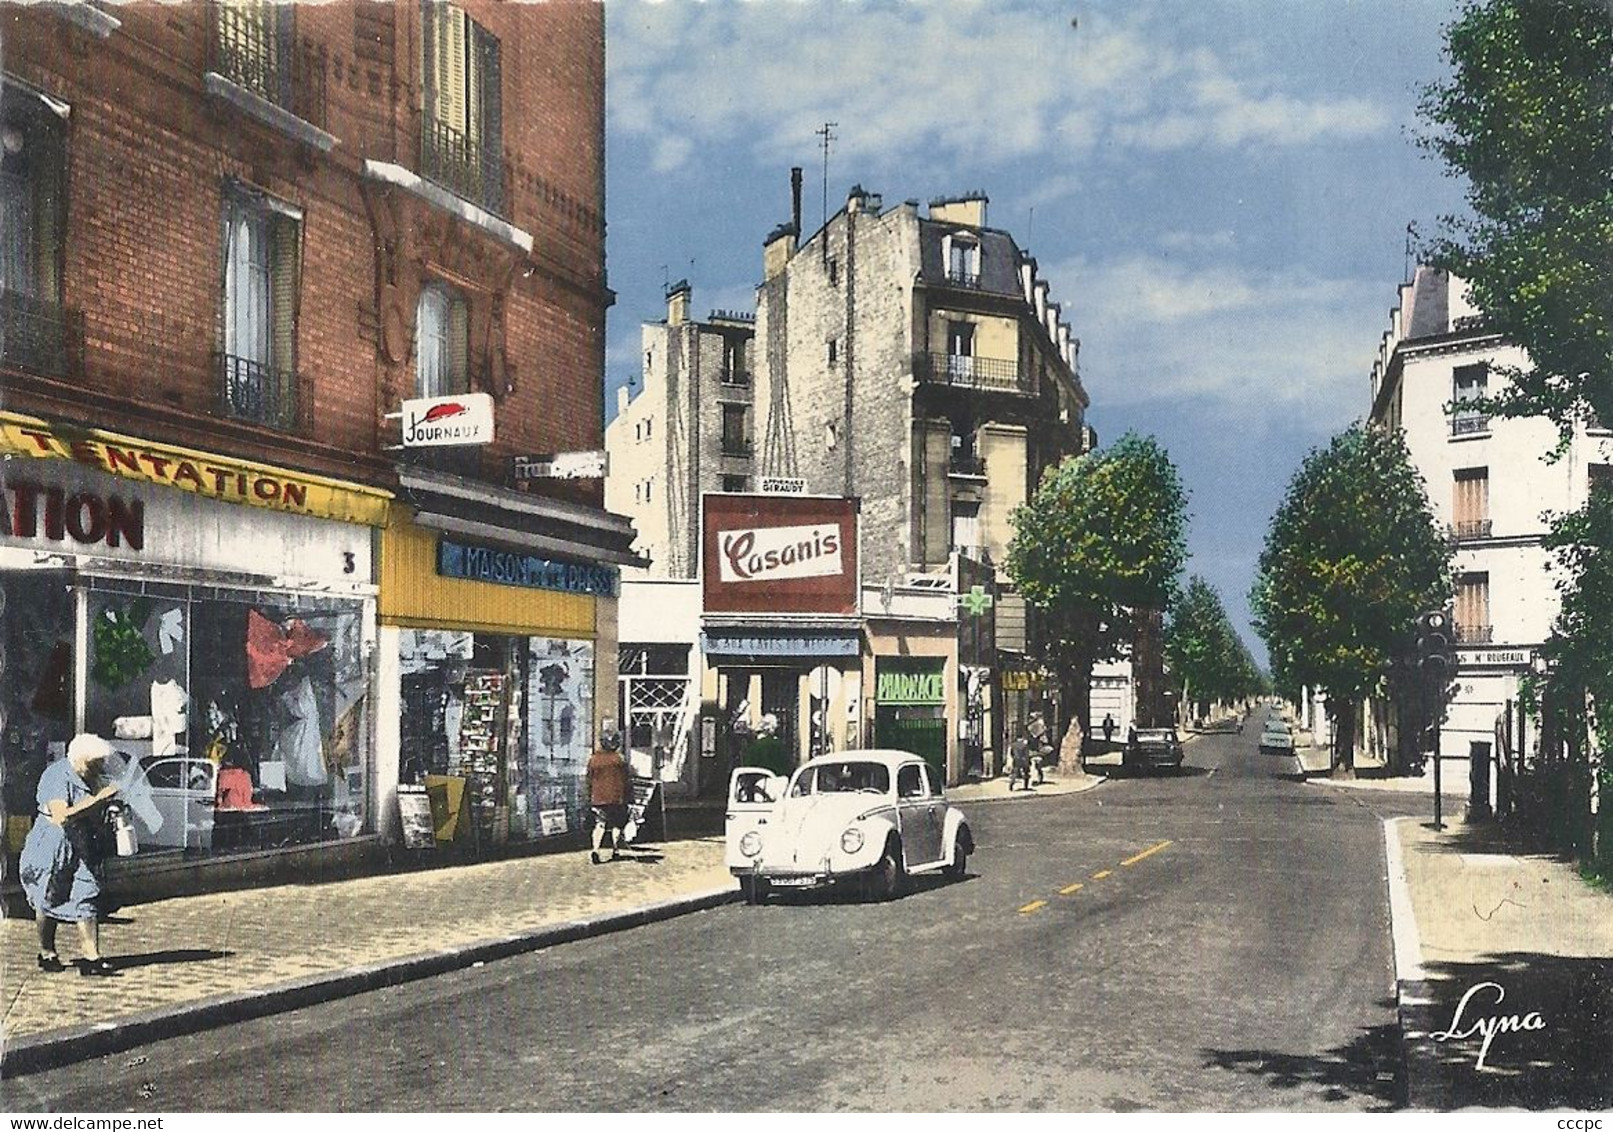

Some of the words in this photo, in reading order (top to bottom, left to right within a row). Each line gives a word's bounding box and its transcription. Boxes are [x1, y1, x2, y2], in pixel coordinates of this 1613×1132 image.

[405, 412, 479, 442] JOURNAUX
[343, 551, 356, 574] 3
[467, 546, 528, 585] MAISON
[724, 531, 838, 578] Casanis
[878, 673, 944, 700] PHARMACIE
